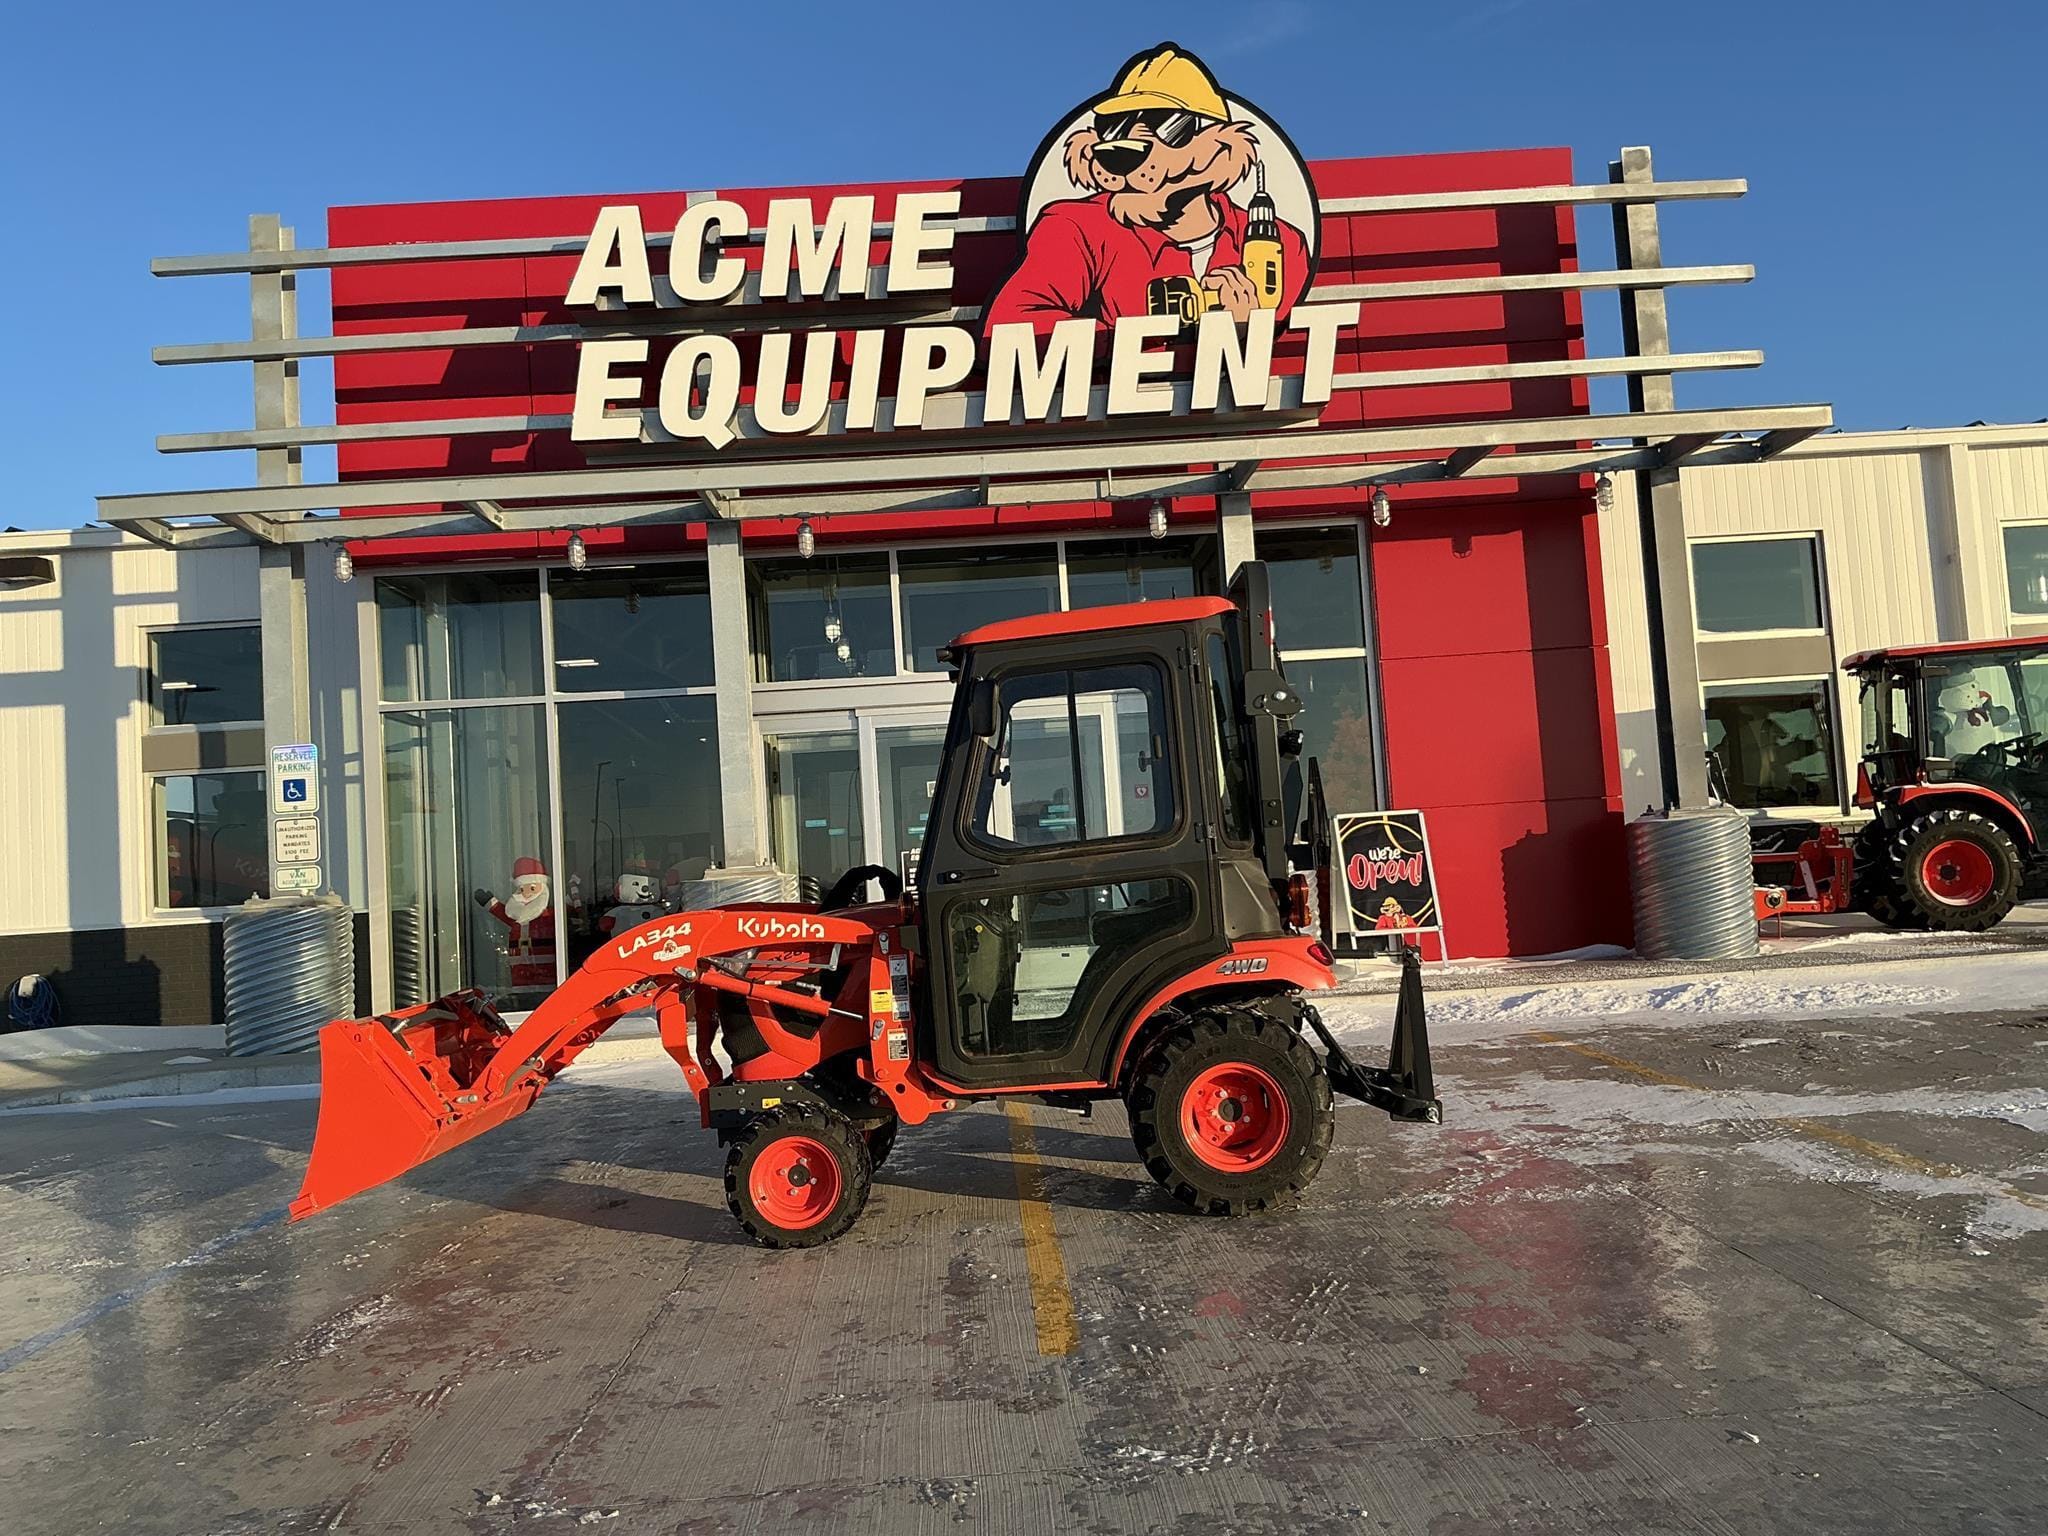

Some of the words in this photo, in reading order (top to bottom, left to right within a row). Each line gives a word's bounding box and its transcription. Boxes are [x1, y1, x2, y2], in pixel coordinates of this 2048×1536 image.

[565, 190, 962, 307] ACME
[571, 302, 1361, 451] EQUIPMENT
[274, 751, 314, 762] RESERVED
[277, 762, 311, 773] PARKING
[1368, 846, 1401, 861] We're
[290, 871, 306, 879] VAN
[1347, 852, 1423, 891] Open!
[737, 917, 825, 938] Kubota
[617, 921, 692, 959] LA344
[1215, 957, 1269, 976] 4WD
